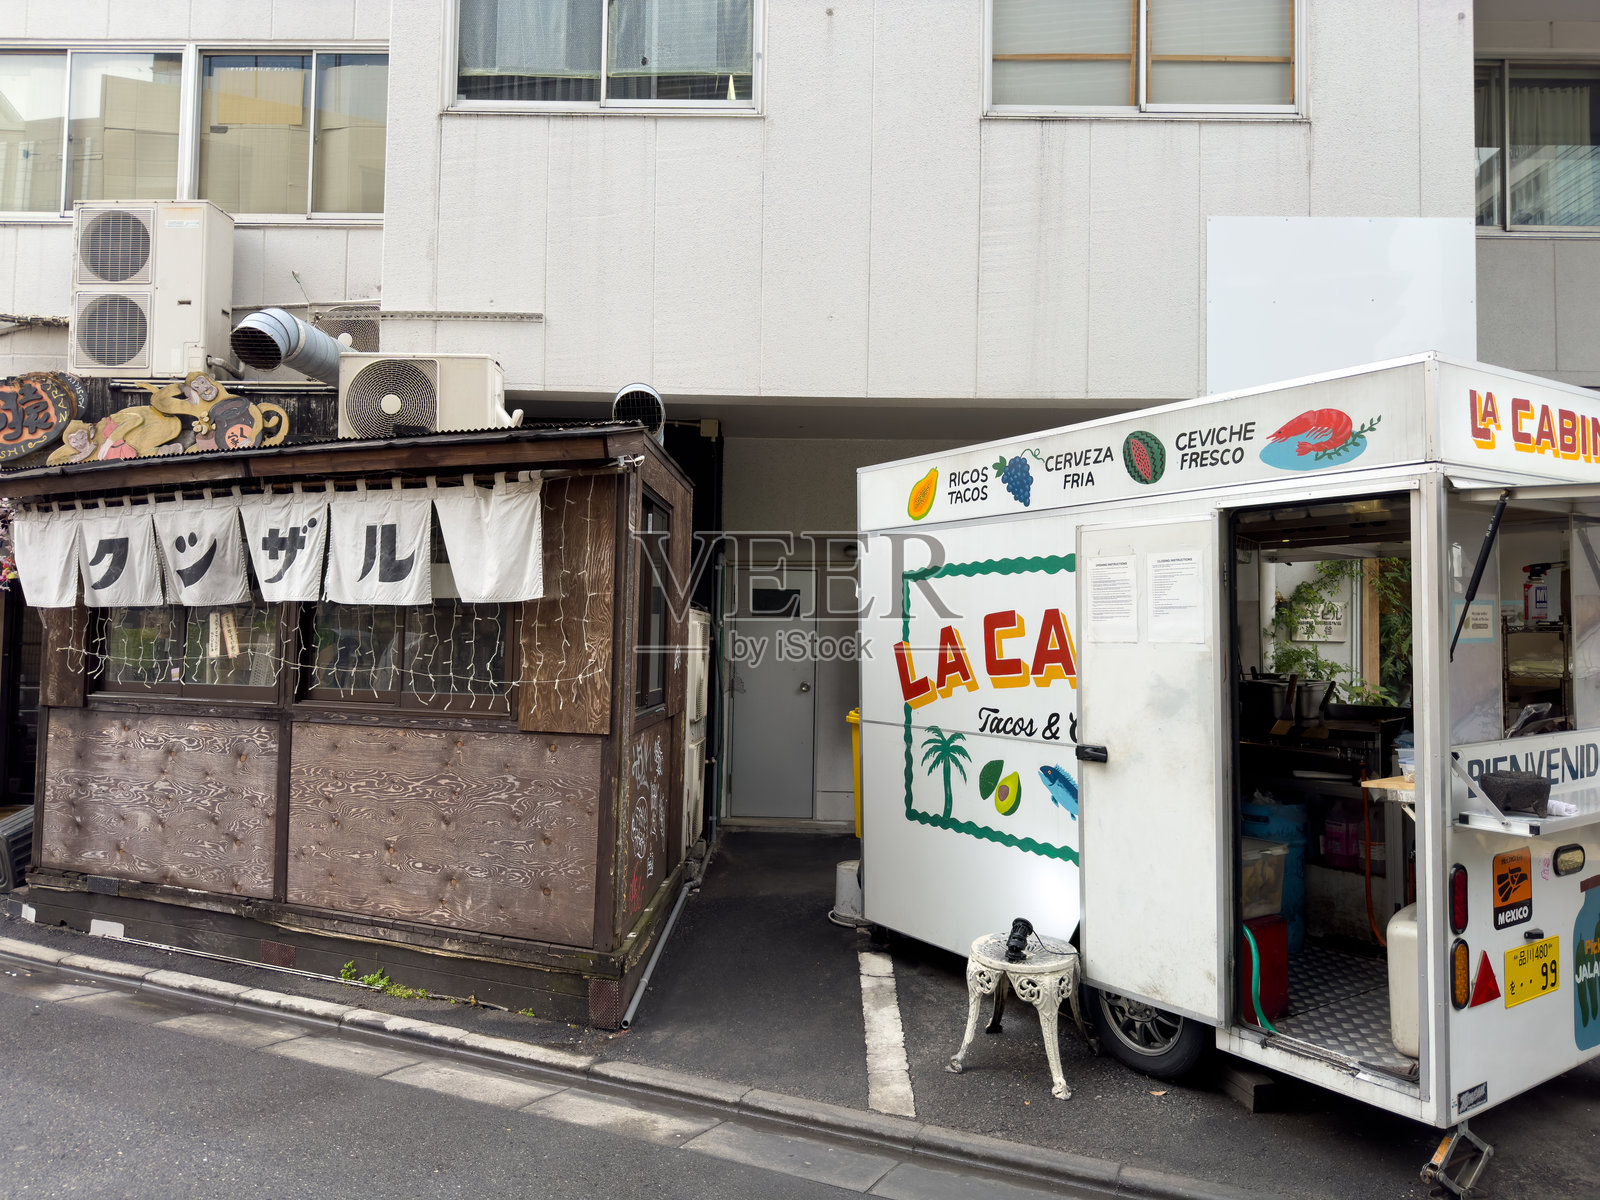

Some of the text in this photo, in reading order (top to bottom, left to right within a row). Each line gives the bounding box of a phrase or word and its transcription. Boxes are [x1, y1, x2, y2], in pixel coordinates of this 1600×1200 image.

[1469, 389, 1502, 449] LA
[1175, 421, 1256, 450] CEVICHE
[1045, 446, 1114, 472] CERVEZA
[1180, 446, 1244, 470] FRESCO
[948, 467, 989, 489] RICOS
[1063, 474, 1095, 490] FRIA
[948, 485, 988, 505] TACOS
[894, 608, 1077, 708] LA CA
[979, 707, 1038, 737] Tacos
[1042, 712, 1060, 740] &
[1575, 960, 1600, 984] JALA
